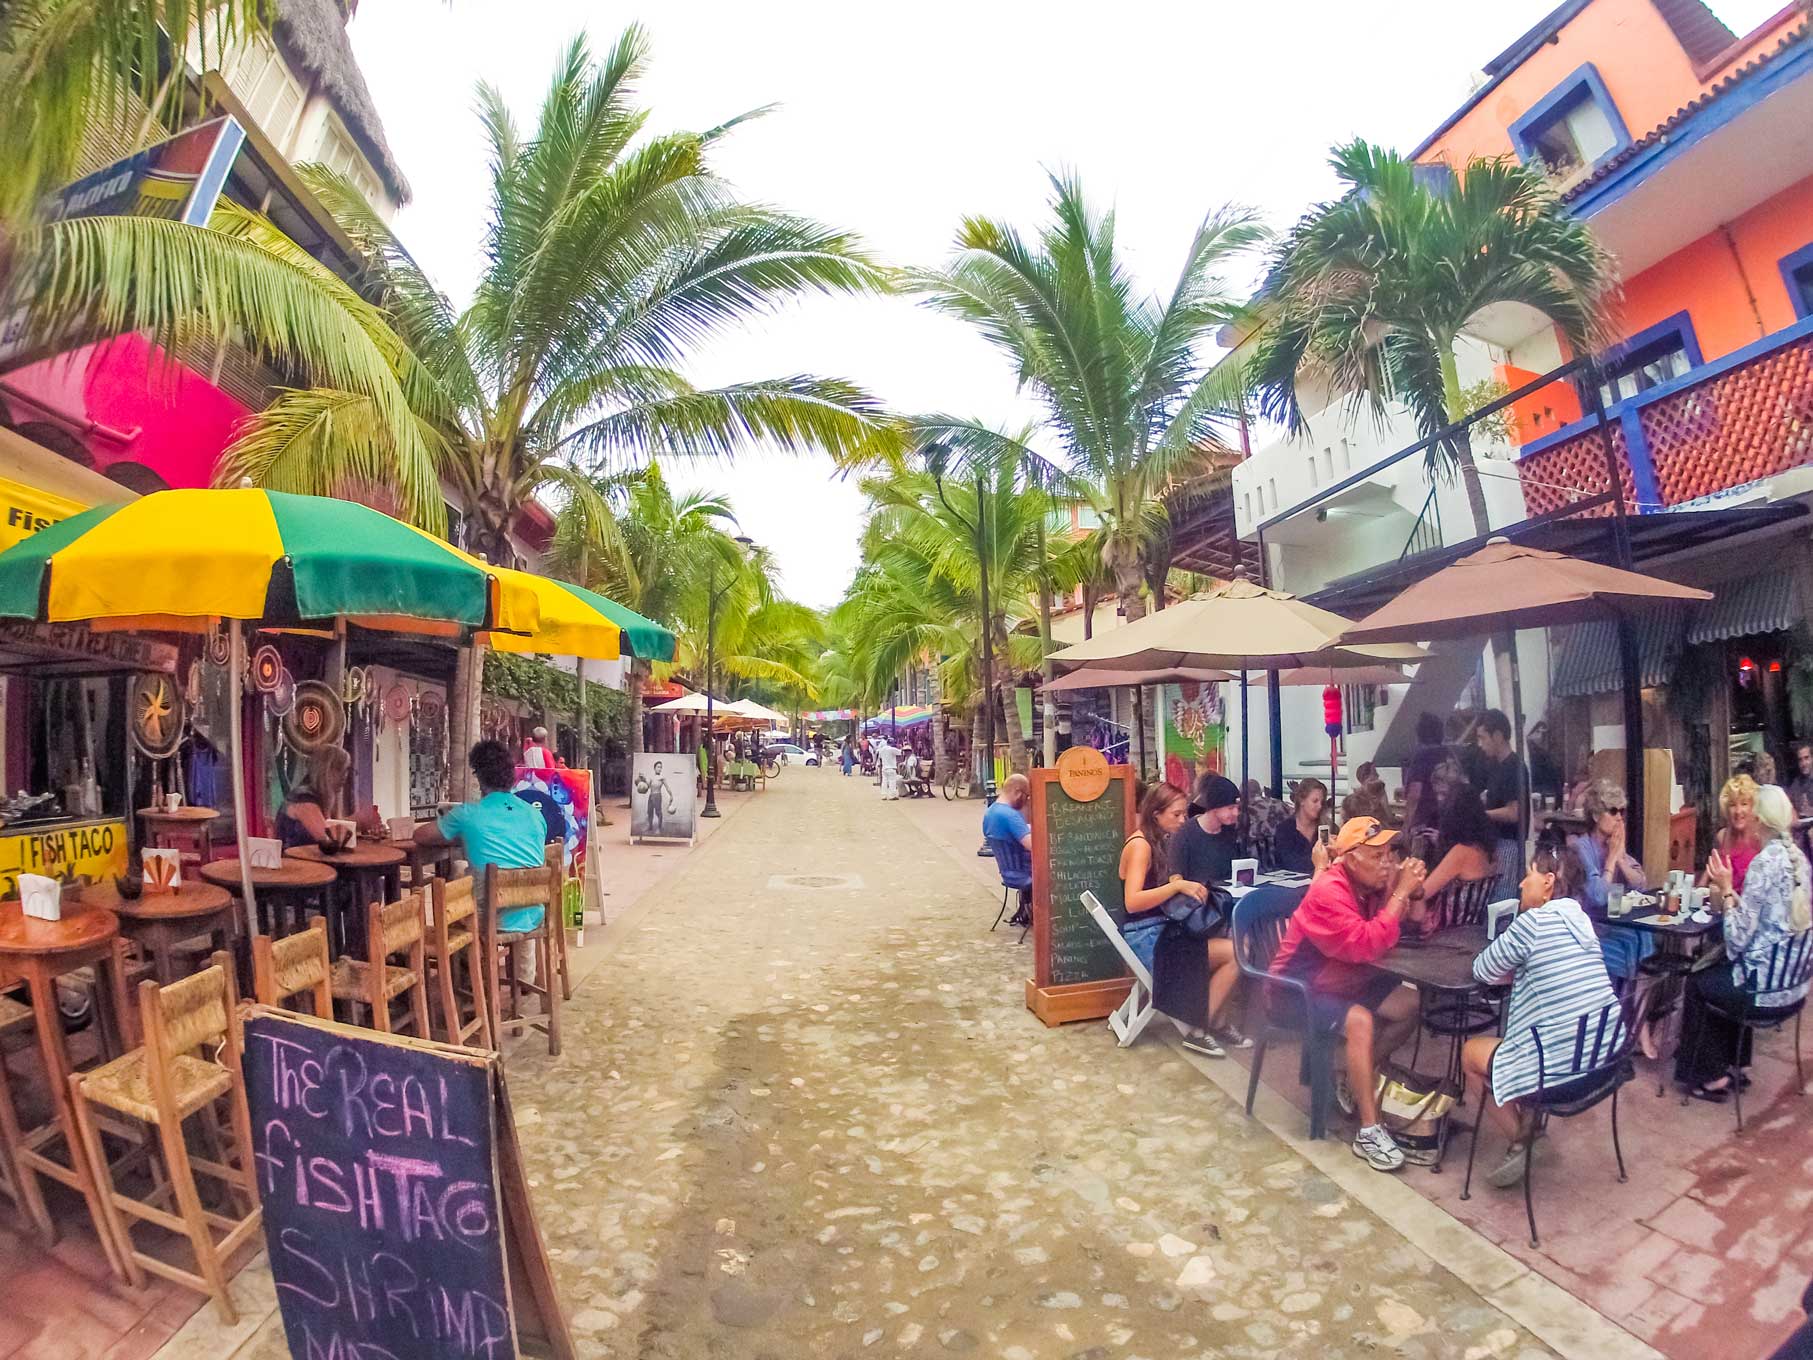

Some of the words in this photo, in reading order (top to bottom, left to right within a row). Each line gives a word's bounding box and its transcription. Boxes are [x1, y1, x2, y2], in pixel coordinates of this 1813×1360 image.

[8, 506, 62, 533] Fis
[30, 833, 66, 868] FISH
[69, 826, 113, 860] TACO
[324, 1045, 478, 1148] REAL
[364, 1148, 490, 1252] TACO
